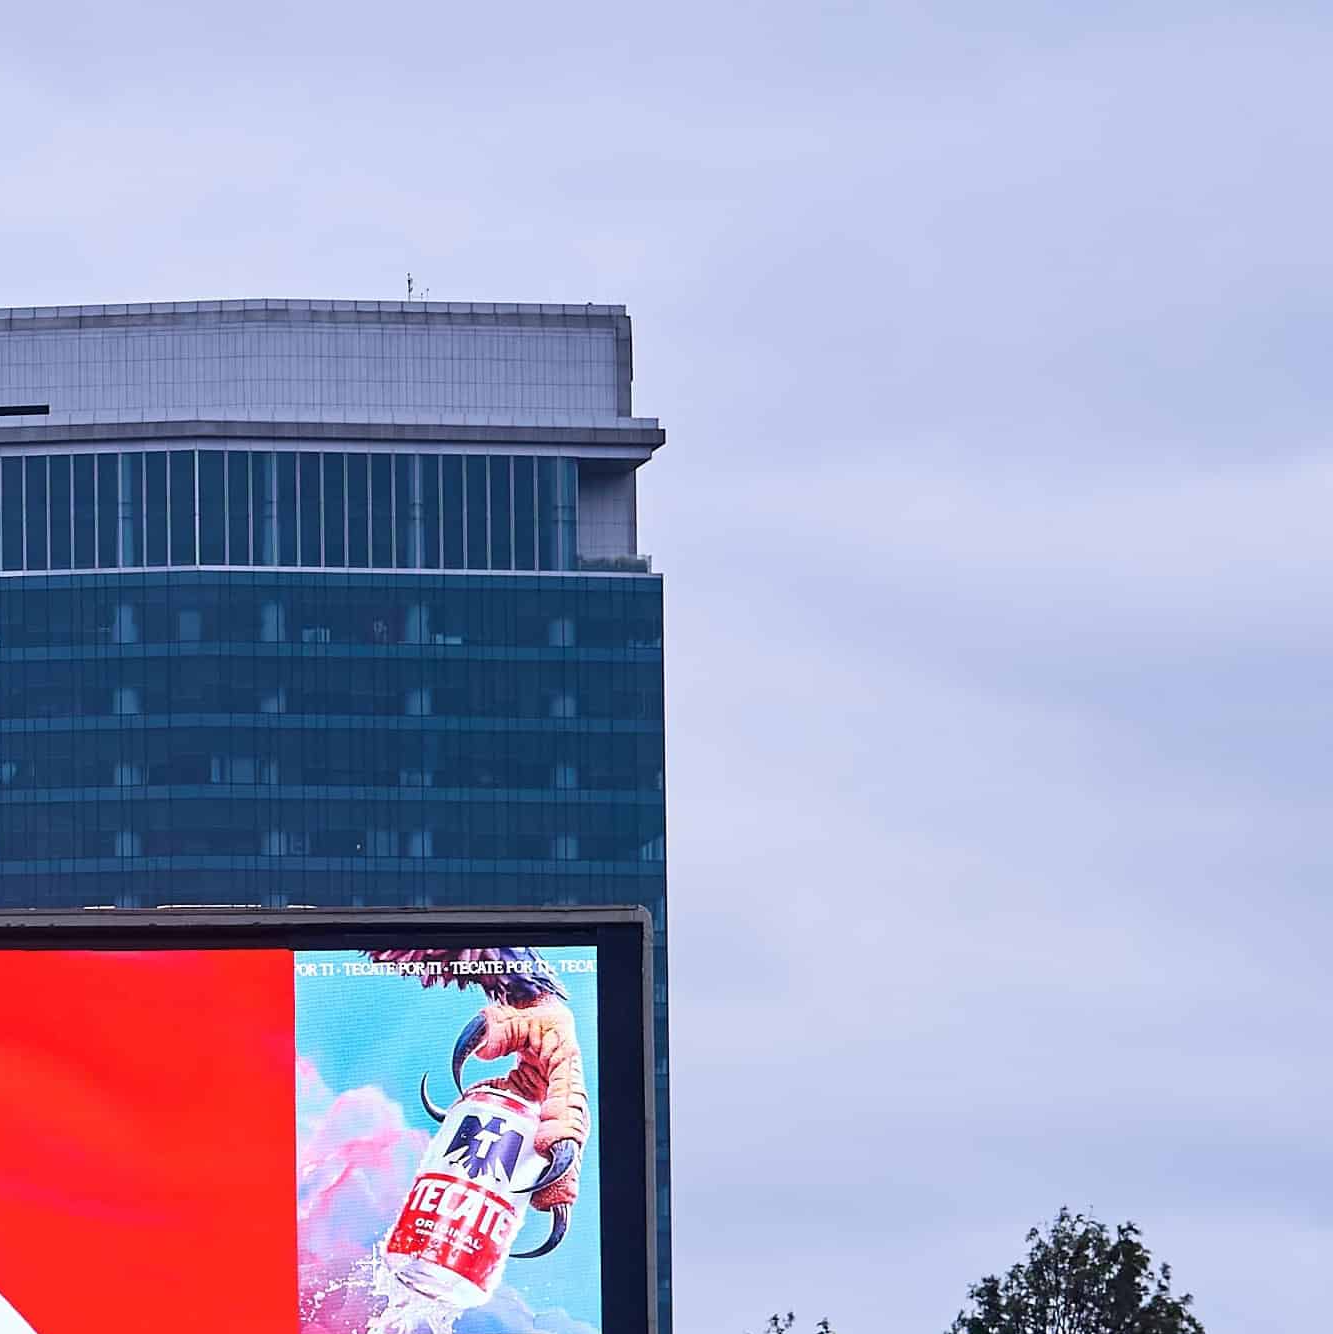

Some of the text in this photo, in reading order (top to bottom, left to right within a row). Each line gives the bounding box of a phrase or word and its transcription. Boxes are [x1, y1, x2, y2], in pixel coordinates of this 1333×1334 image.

[342, 962, 394, 976] TECATE
[398, 962, 425, 976] POR
[450, 961, 504, 975] TECATE
[506, 961, 534, 974] POR
[410, 1178, 518, 1243] TECATE
